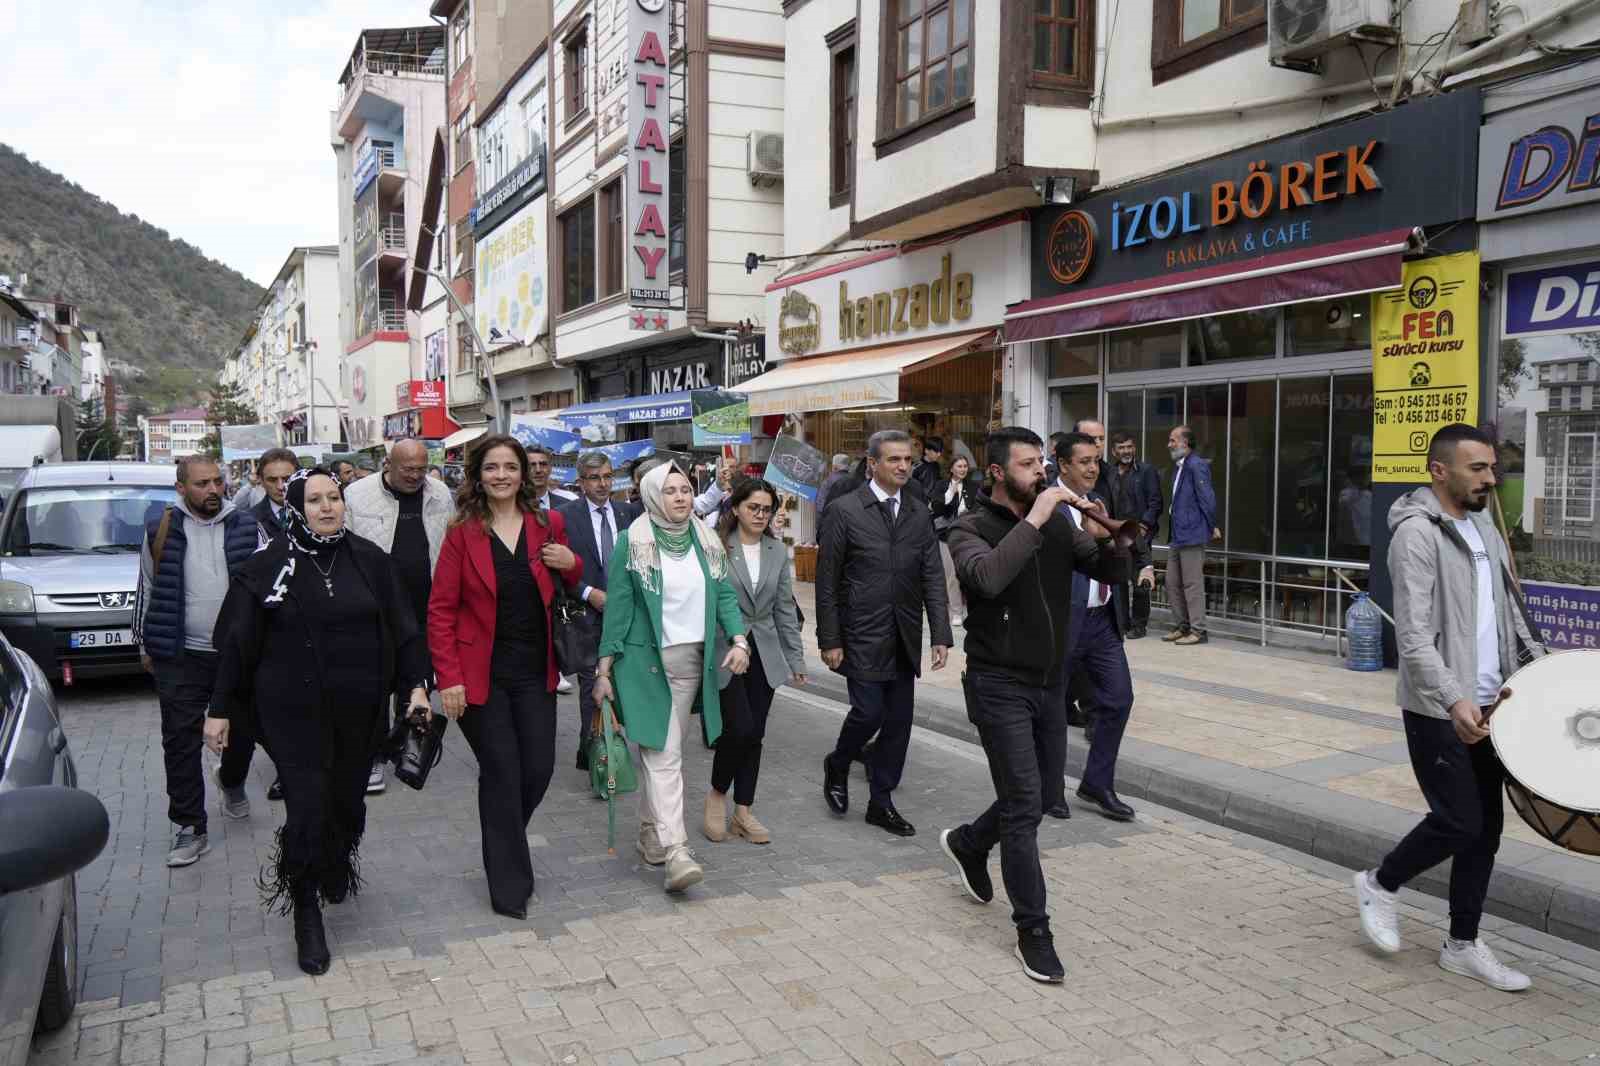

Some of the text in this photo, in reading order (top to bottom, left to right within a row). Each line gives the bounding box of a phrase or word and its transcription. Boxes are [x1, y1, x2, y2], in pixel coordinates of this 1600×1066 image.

[635, 31, 666, 280] ATALAY
[1111, 199, 1201, 251] İZOL
[1211, 140, 1380, 227] BÖREK
[1166, 220, 1312, 268] BAKLAVA & CAFE
[839, 253, 974, 343] hanzade
[651, 362, 709, 395] NAZAR
[1407, 395, 1424, 408] 545
[1426, 394, 1441, 407] 213
[1442, 393, 1454, 406] 46
[1455, 392, 1468, 405] 67
[629, 406, 685, 420] NAZAR SHOP
[1374, 412, 1387, 424] Tel
[1406, 411, 1423, 423] 456
[1425, 410, 1439, 422] 213
[1441, 409, 1453, 422] 46
[1455, 408, 1467, 421] 67
[1520, 593, 1599, 611] ümüşhane
[80, 632, 122, 645] 29 DA
